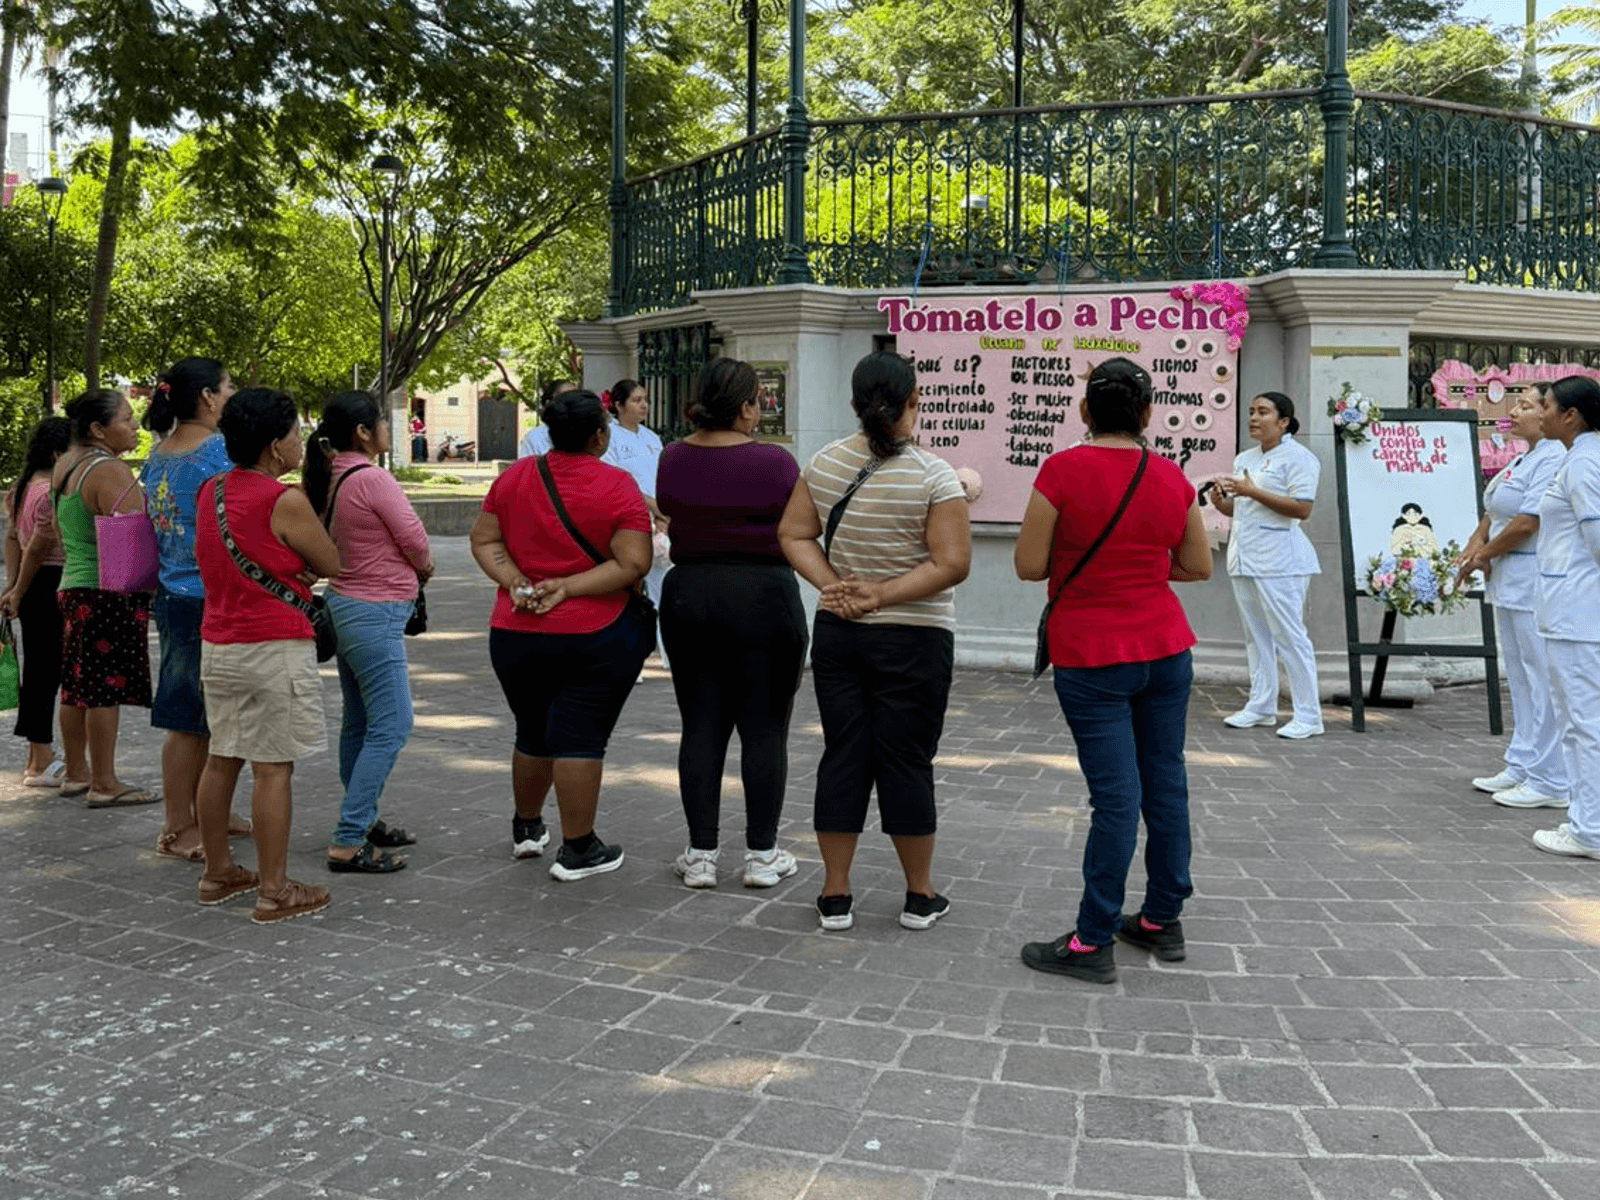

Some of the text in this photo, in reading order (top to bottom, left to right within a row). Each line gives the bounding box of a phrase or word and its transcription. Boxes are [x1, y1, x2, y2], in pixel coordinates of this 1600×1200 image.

[878, 296, 1229, 333] Tómatelo a Pecho
[954, 354, 982, 378] ES?
[1011, 356, 1071, 371] FACTORES
[1152, 358, 1198, 373] SIGNOS
[1011, 371, 1075, 387] DE RIESGO
[918, 379, 985, 396] ecimiento
[1035, 391, 1073, 407] mujer
[1151, 387, 1203, 406] ÍNTOMAS
[920, 417, 985, 431] las células
[1371, 421, 1420, 437] Unidos
[930, 435, 959, 448] seno
[1155, 436, 1216, 451] ME DEBO
[1380, 436, 1446, 451] contra el
[1430, 449, 1447, 465] de
